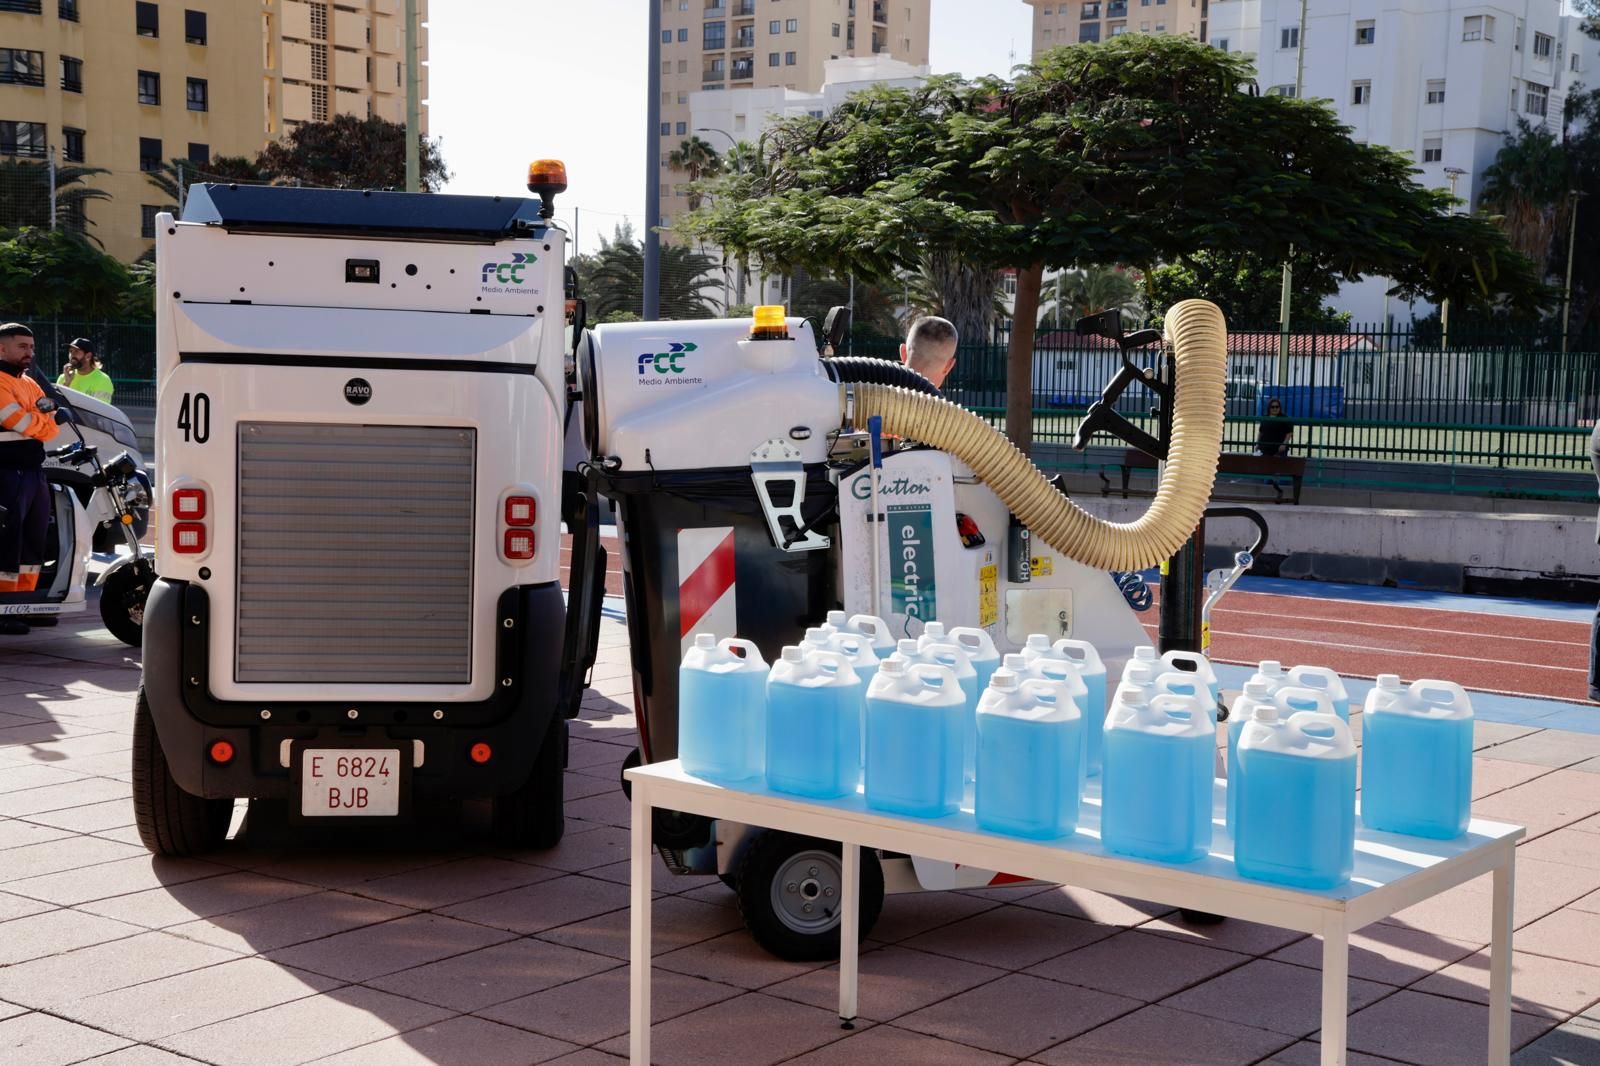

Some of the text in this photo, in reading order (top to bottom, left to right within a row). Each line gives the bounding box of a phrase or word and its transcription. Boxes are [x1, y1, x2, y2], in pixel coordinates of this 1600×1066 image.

[482, 263, 526, 284] FCC
[505, 287, 539, 295] Ambiente
[638, 352, 686, 374] FCC
[346, 386, 370, 394] RAVO
[638, 376, 703, 386] Medio Ambiente
[177, 392, 210, 444] 40
[902, 525, 923, 616] electric
[4, 604, 31, 614] 100%
[312, 756, 390, 778] E 6824
[328, 787, 369, 809] BJB
